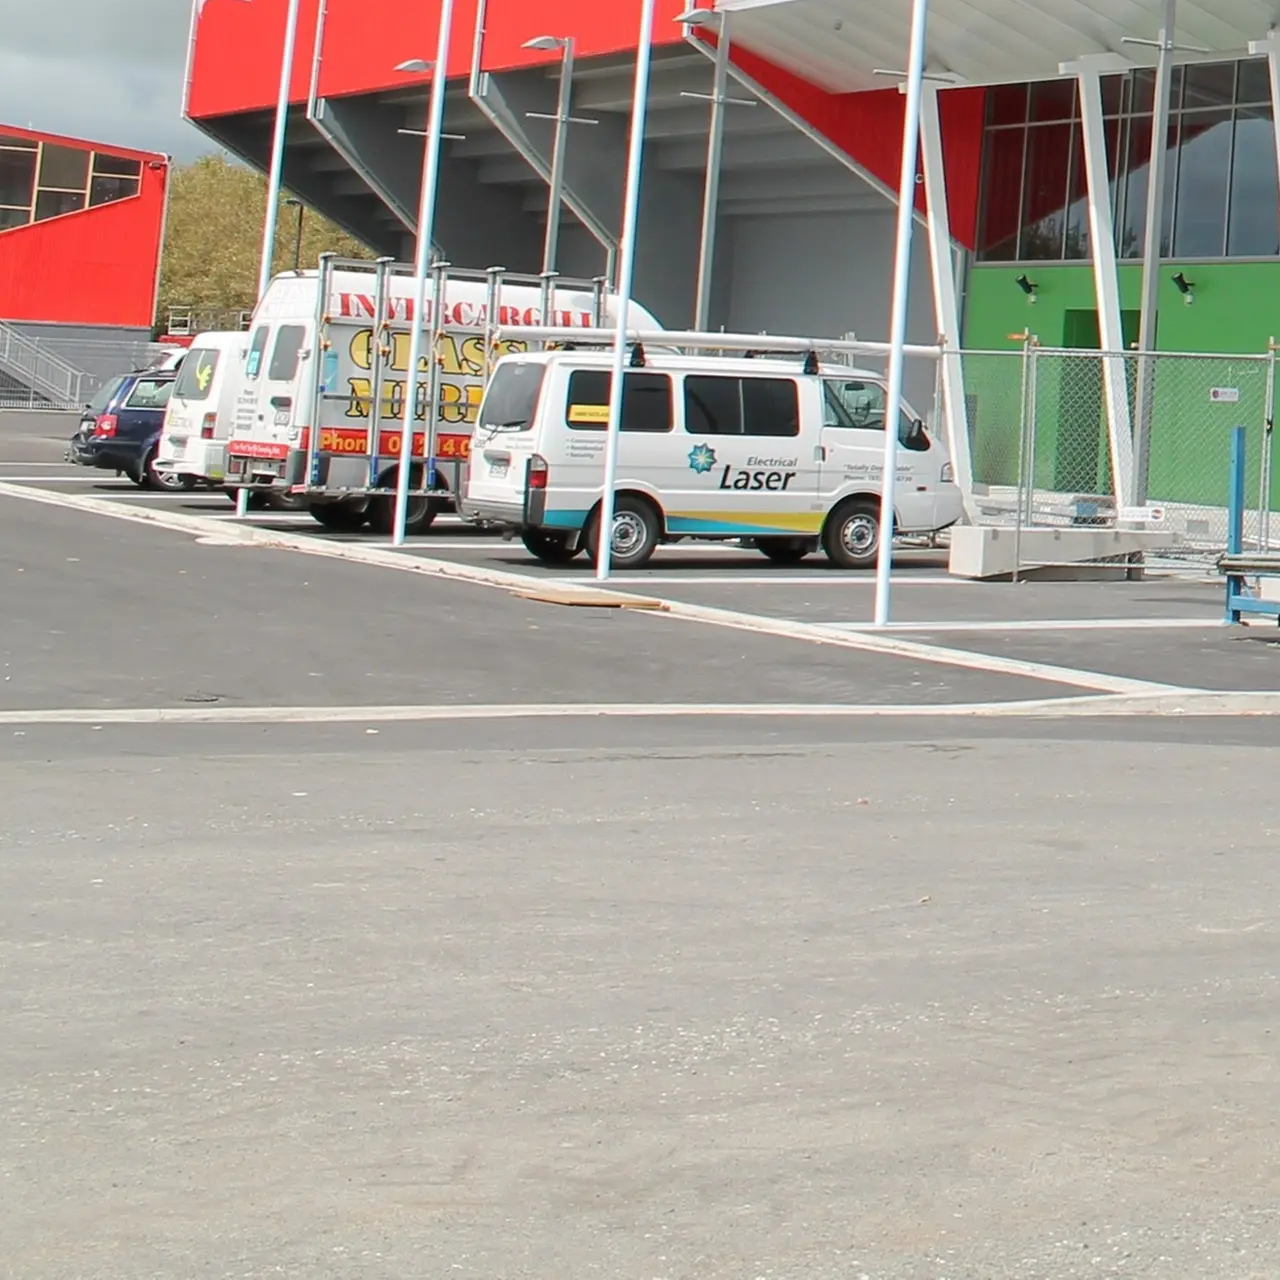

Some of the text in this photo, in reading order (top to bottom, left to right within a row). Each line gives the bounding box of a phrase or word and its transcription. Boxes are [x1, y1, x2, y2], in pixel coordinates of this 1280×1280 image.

[320, 431, 367, 451] Phon
[747, 456, 798, 468] Electrical
[720, 464, 796, 491] Laser
